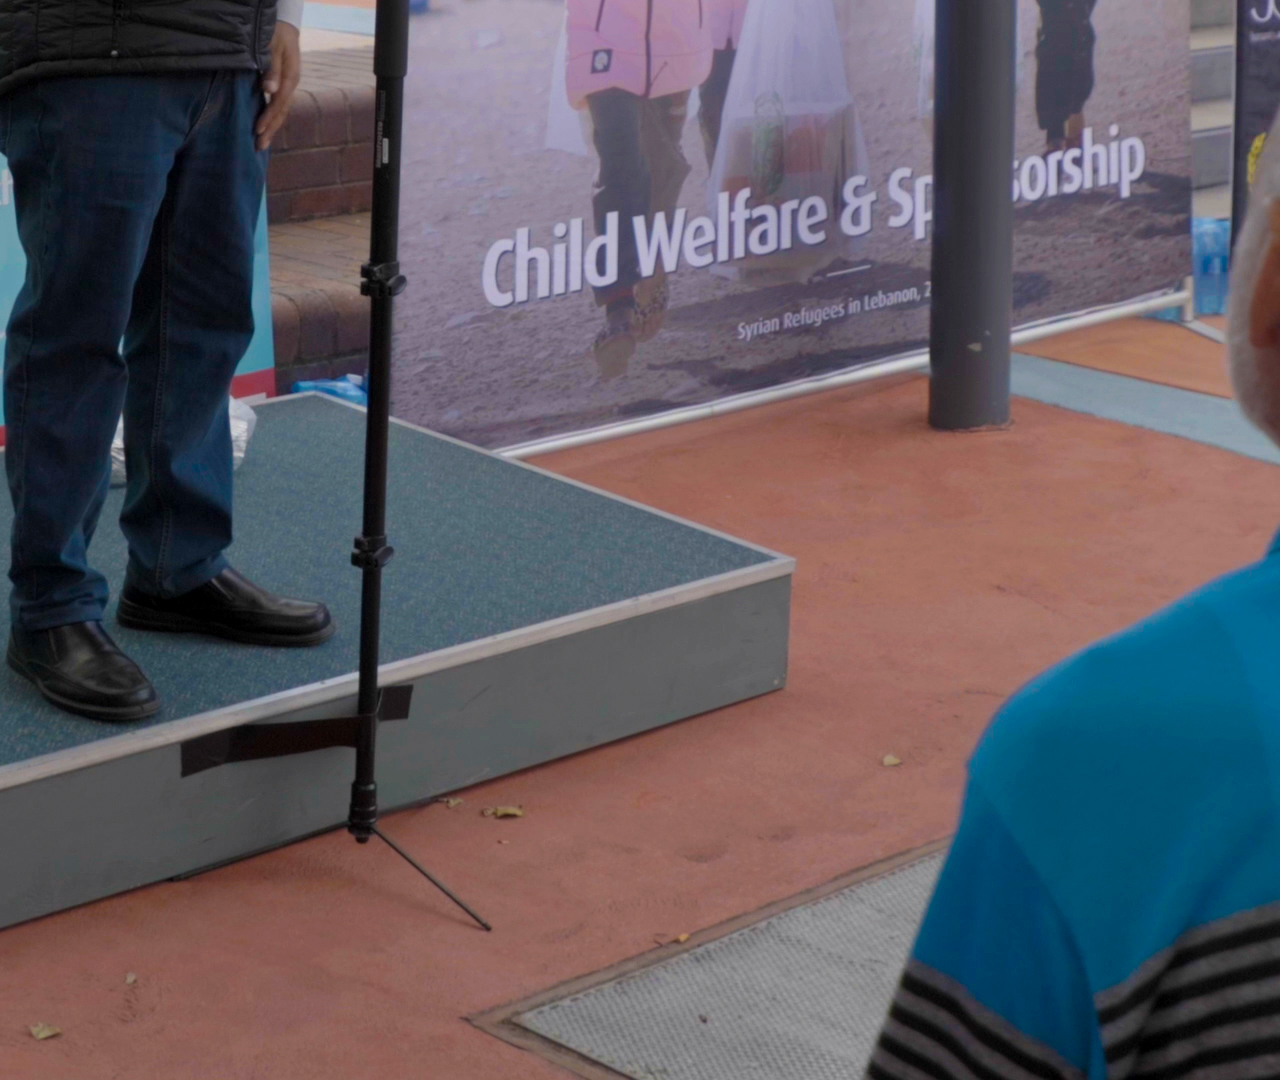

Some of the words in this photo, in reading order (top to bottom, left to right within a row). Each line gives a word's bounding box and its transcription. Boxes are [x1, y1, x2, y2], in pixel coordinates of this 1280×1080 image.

[482, 211, 619, 308] Child
[632, 187, 828, 279] Welfare
[840, 174, 878, 236] &
[737, 317, 780, 341] Syrian
[783, 303, 845, 329] Refugees
[848, 297, 861, 314] in
[864, 286, 921, 310] Lebanon,
